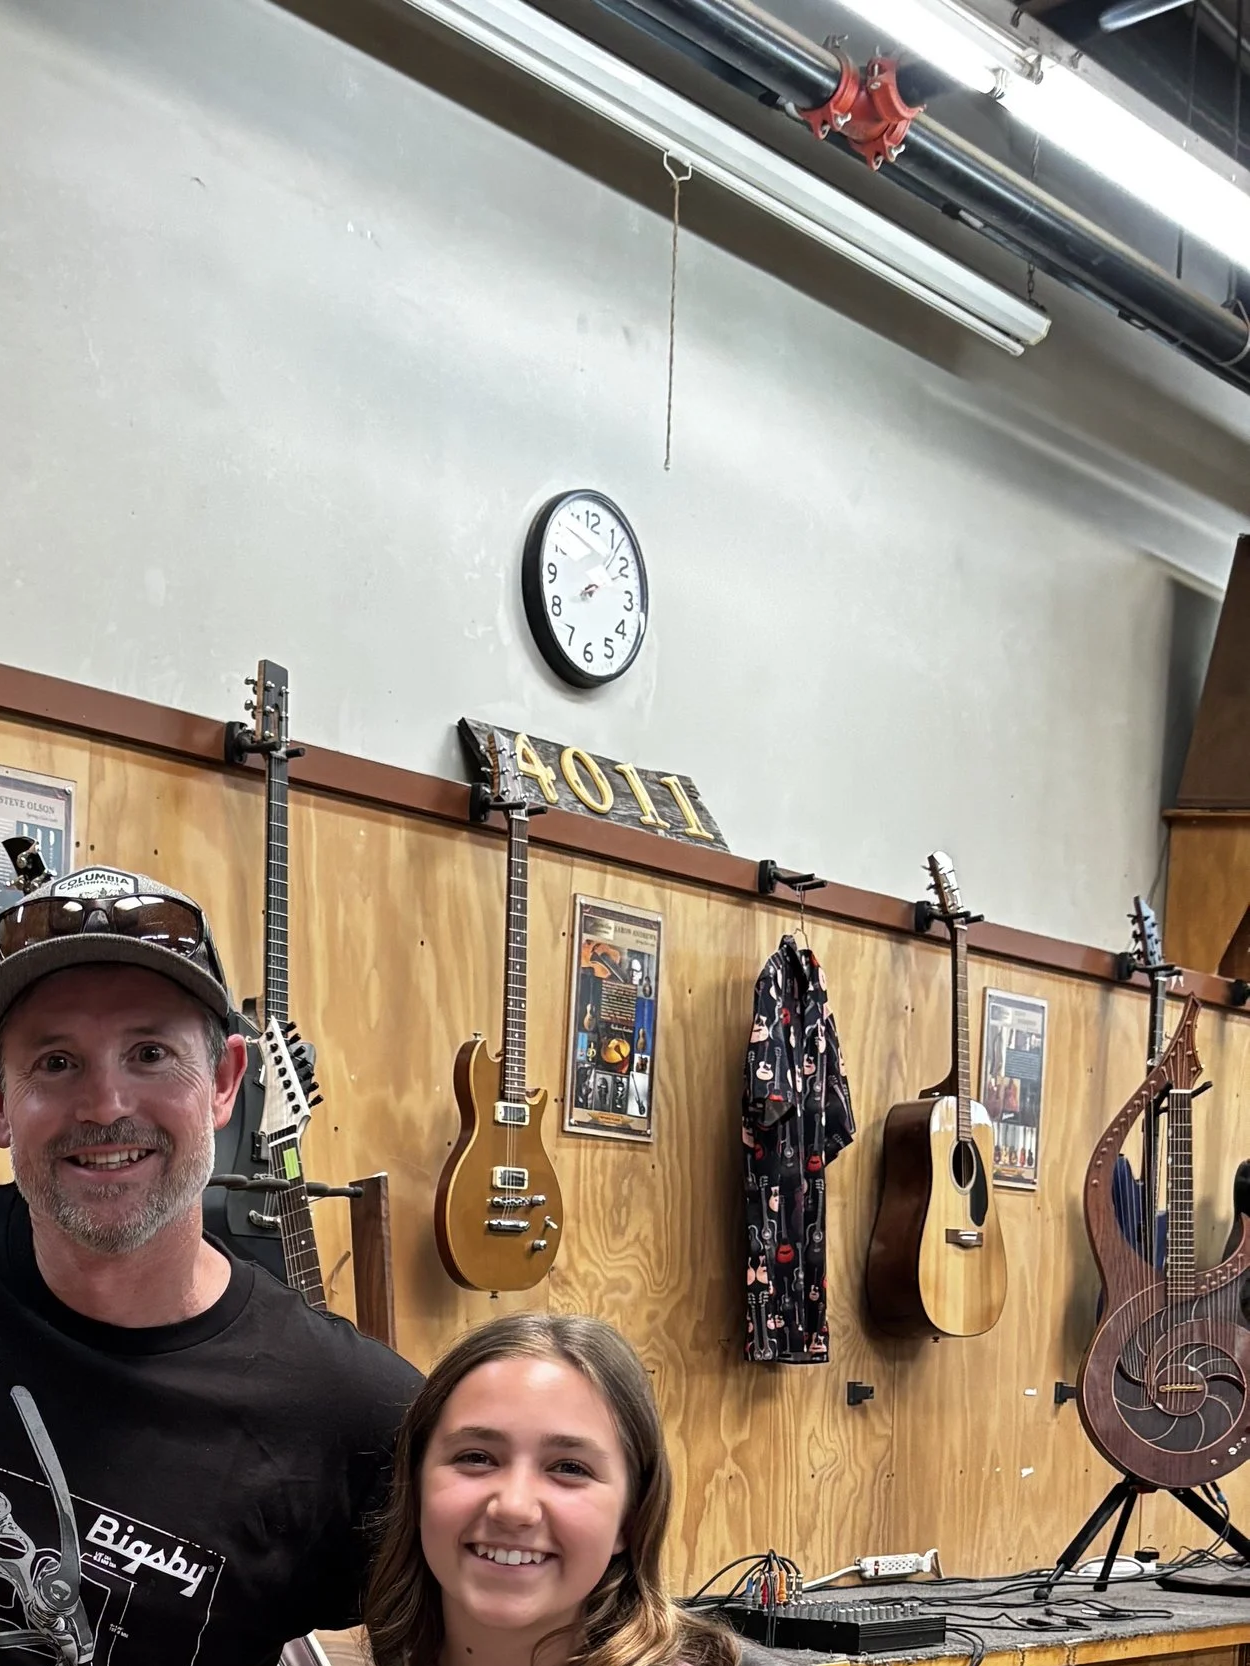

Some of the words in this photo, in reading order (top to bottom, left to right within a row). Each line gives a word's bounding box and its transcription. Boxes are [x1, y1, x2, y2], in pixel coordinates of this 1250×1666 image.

[585, 510, 601, 535] 12
[610, 529, 616, 549] 1
[547, 562, 558, 584] 9
[619, 556, 629, 578] 2
[551, 595, 562, 617] 8
[623, 590, 634, 612] 3
[565, 622, 576, 647] 7
[615, 619, 627, 640] 4
[583, 642, 594, 663] 6
[603, 637, 615, 660] 5
[515, 734, 714, 839] 4011
[27, 801, 55, 814] OLSON
[58, 872, 129, 890] COLUMBIA
[85, 1514, 208, 1598] Bigsby
